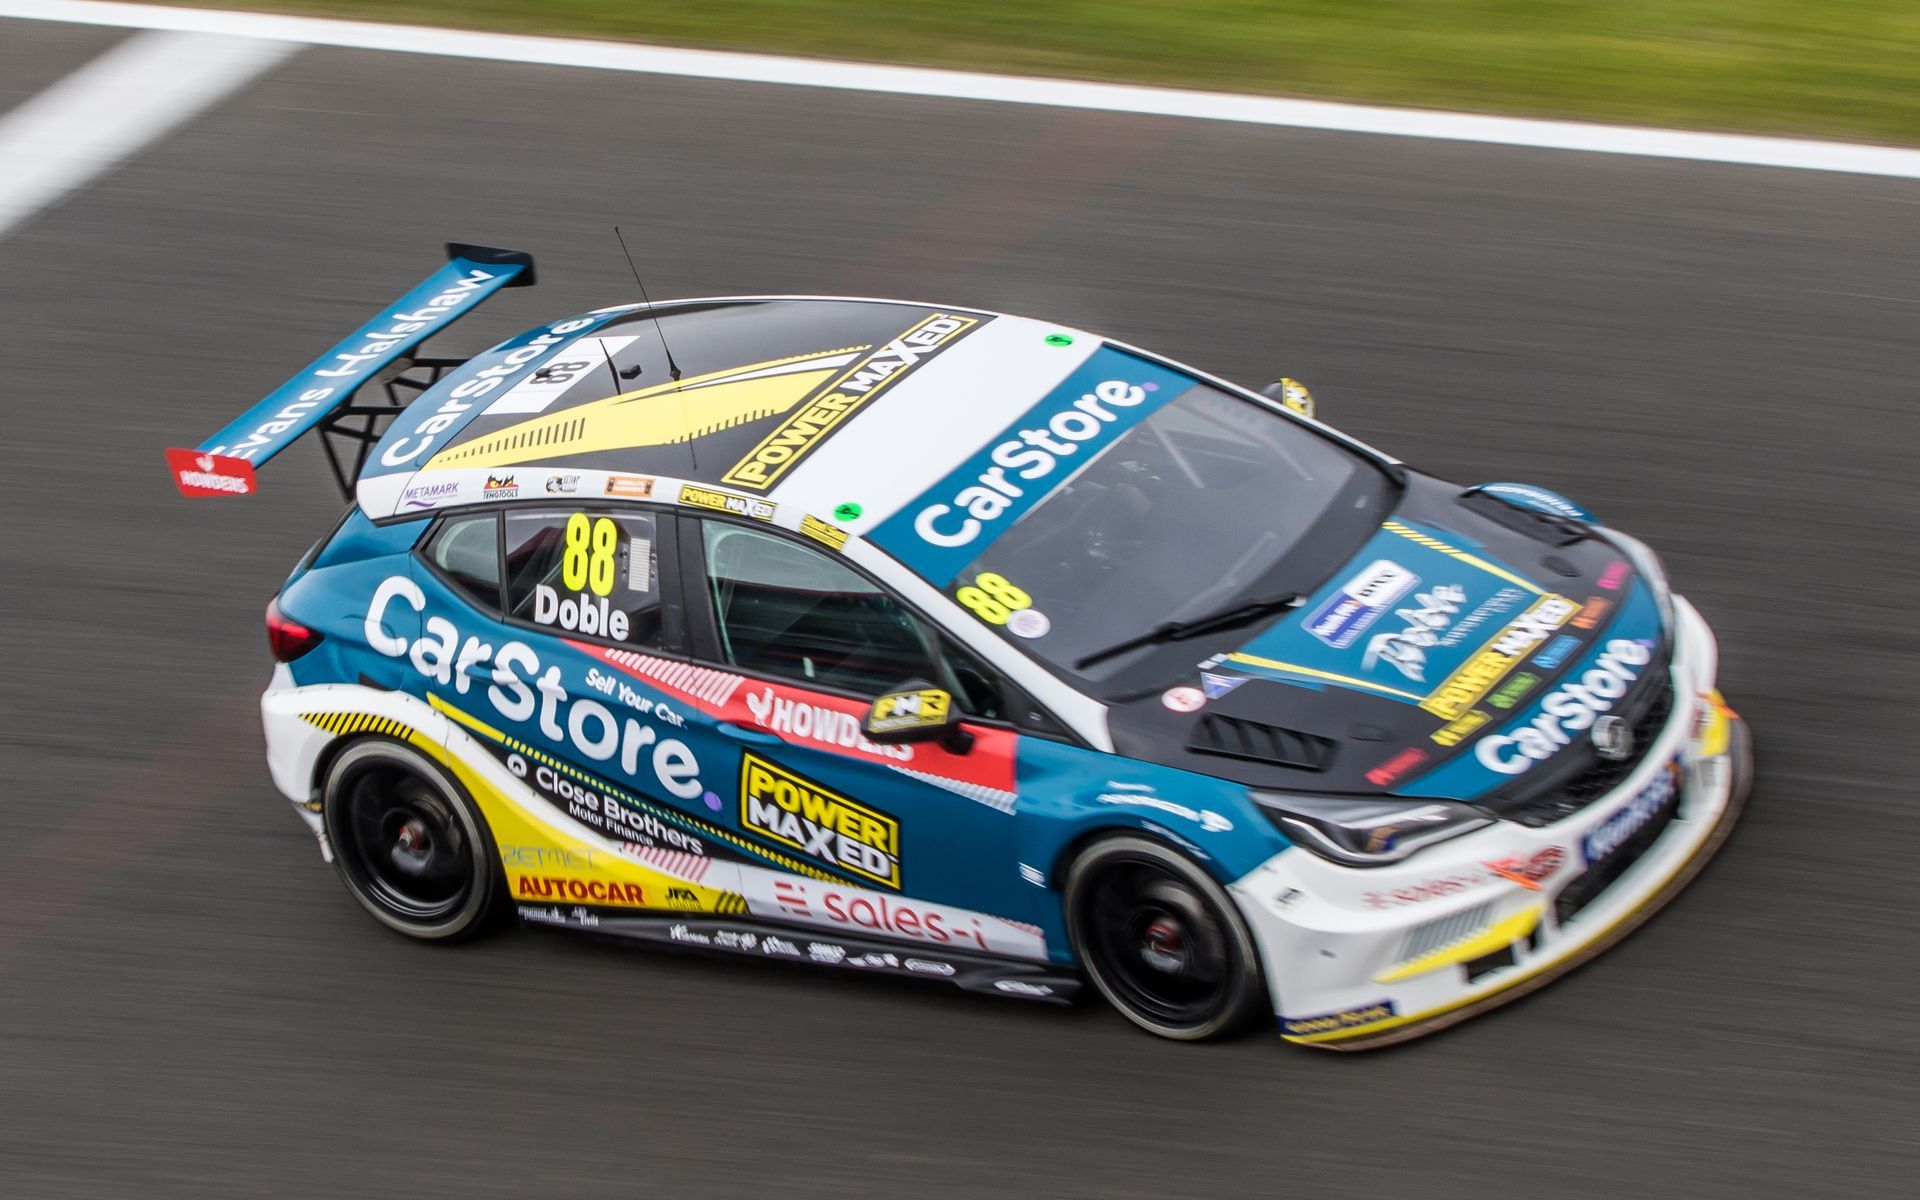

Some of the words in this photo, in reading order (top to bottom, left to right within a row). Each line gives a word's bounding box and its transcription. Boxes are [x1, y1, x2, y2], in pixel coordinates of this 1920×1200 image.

[317, 269, 495, 377] Halshaw
[734, 392, 861, 484] POWER
[840, 315, 962, 392] MAXED
[405, 482, 459, 499] METAMARK
[682, 488, 726, 508] POWER
[726, 497, 775, 517] MAXED
[563, 512, 617, 597] 88
[534, 583, 629, 641] Doble
[957, 572, 1033, 625] 88
[585, 668, 616, 696] Sell
[618, 682, 654, 714] Your
[1430, 651, 1515, 719] POWER
[536, 766, 599, 811] Close
[604, 795, 703, 855] Brothers
[569, 801, 603, 826] Motor
[606, 818, 654, 847] Finance
[748, 795, 898, 877] MAXED
[750, 765, 888, 852] POWER
[519, 876, 646, 904] AUTOCAR
[823, 891, 989, 950] sales-i
